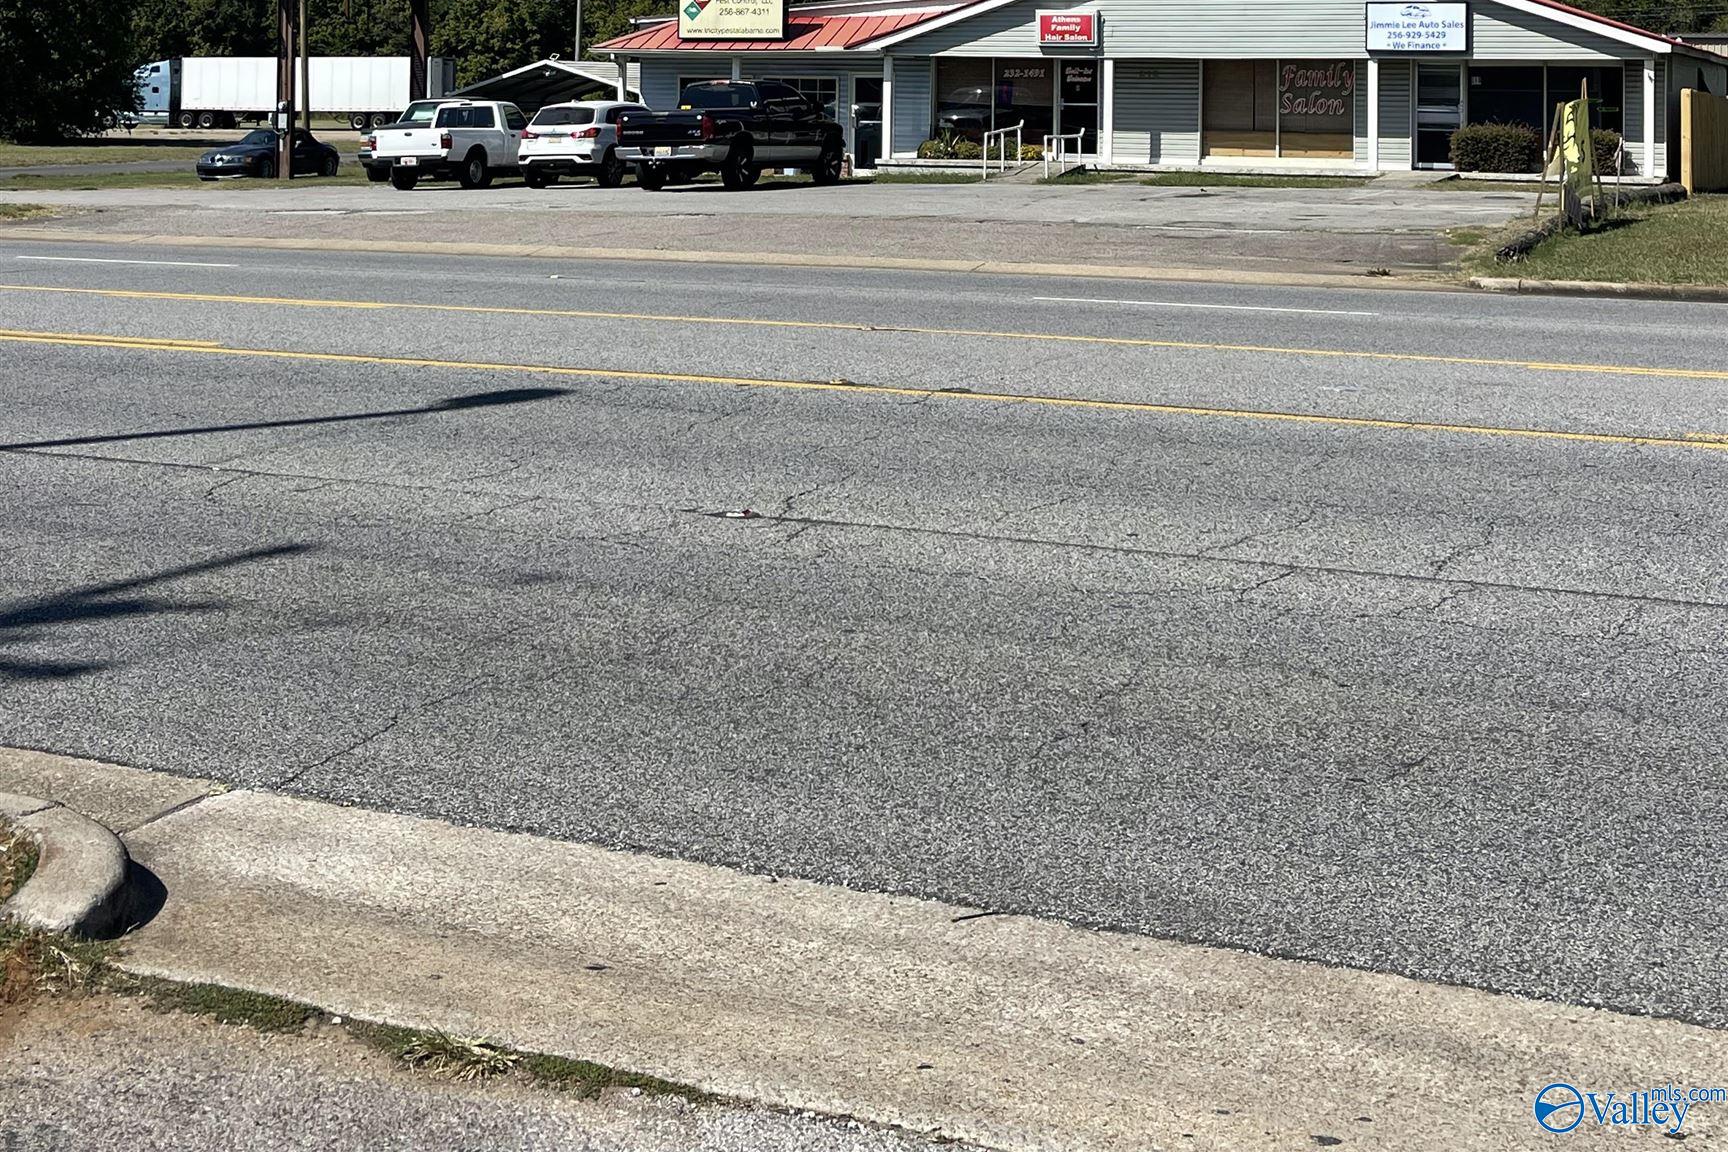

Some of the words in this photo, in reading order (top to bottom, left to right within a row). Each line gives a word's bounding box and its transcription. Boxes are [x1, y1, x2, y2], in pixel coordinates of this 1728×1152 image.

[1051, 15, 1081, 23] Athens
[1050, 24, 1081, 32] Family
[1370, 20, 1400, 29] Jimmie
[1402, 21, 1417, 29] Lee
[1418, 20, 1440, 29] Auto
[1441, 20, 1465, 29] Sales
[1044, 33, 1063, 41] Hair
[1064, 33, 1088, 41] Salon
[1387, 31, 1447, 39] 256-929-5429
[1392, 41, 1406, 49] We
[1407, 41, 1441, 49] Finance
[1279, 61, 1356, 96] Family
[1279, 91, 1345, 115] Salon
